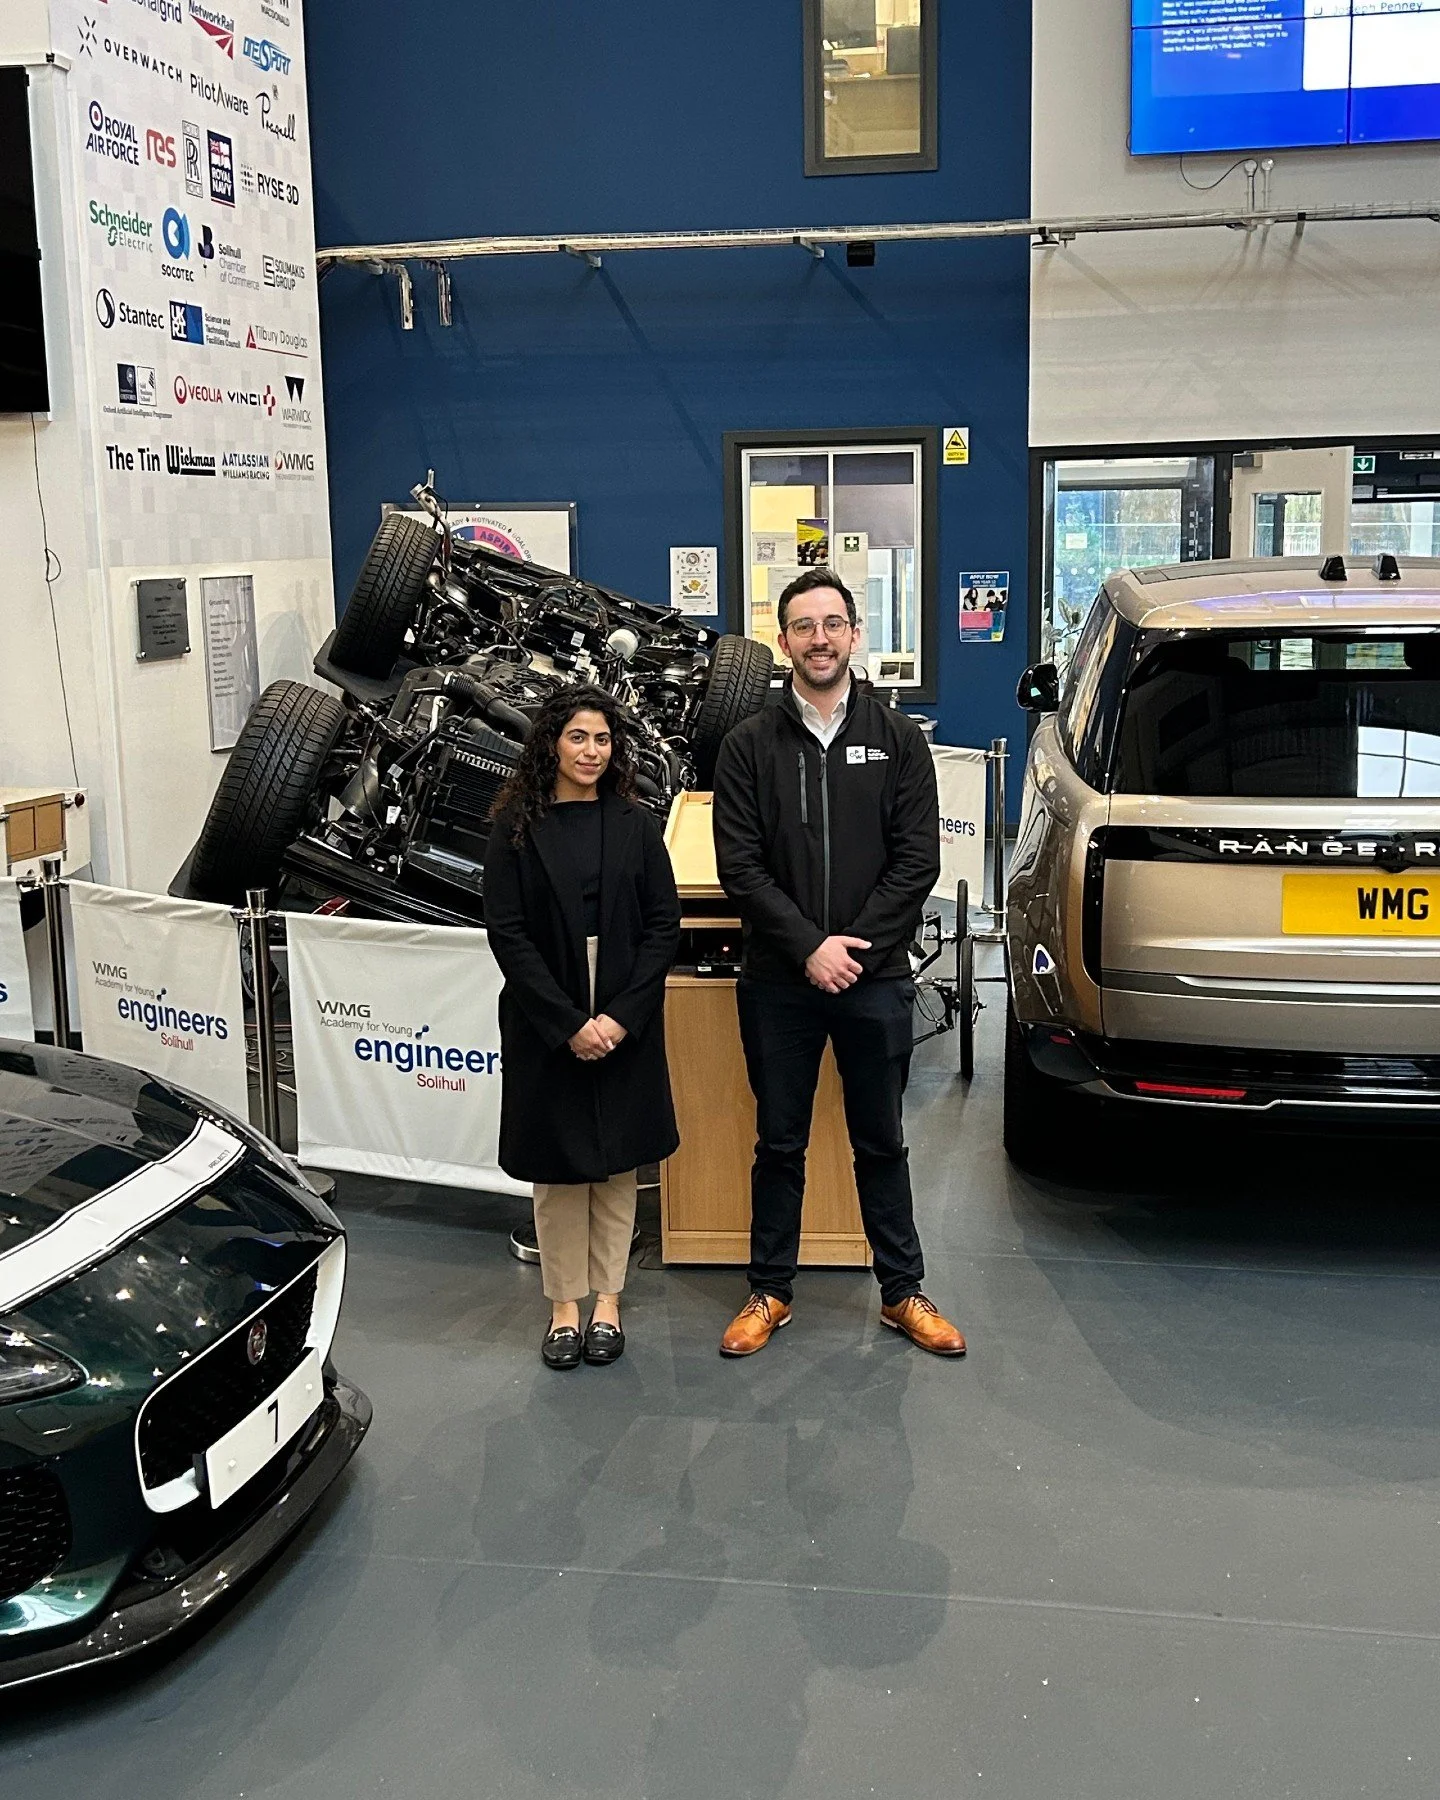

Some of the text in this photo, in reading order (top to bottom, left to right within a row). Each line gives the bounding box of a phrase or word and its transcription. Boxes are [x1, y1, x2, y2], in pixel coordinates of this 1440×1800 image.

[1380, 2, 1423, 12] Penney
[104, 38, 183, 83] OVERWATCH
[104, 115, 139, 145] ROYAL
[86, 132, 139, 166] AIR FORCE
[146, 128, 177, 168] res
[211, 165, 233, 185] ROYAL
[211, 178, 233, 198] NAVY
[257, 172, 300, 206] RYSE 3D
[89, 199, 153, 238] Schneider
[119, 231, 154, 253] Electric
[161, 263, 195, 282] SOCOTEC
[275, 274, 297, 291] GROUP
[119, 302, 165, 330] Stantec
[255, 325, 308, 351] Tilbury Douglas
[187, 385, 223, 404] VEOLIA
[227, 390, 262, 407] VINCI
[282, 408, 312, 423] WARWICK
[106, 444, 216, 475] The Tin Wickman
[229, 453, 269, 468] ATLASSIAN
[282, 452, 315, 471] WMG
[471, 516, 507, 531] MOTIVATED
[1219, 840, 1378, 857] RANGE
[1357, 887, 1430, 921] WMG
[92, 960, 128, 980] WMG
[95, 976, 124, 993] Academy
[133, 984, 155, 1000] Young
[118, 993, 229, 1040] engineers
[317, 1000, 371, 1019] WMG
[320, 1016, 413, 1038] Academy for Young
[160, 1032, 194, 1052] Solihull
[354, 1036, 502, 1075] engineer
[416, 1073, 466, 1092] Solihull
